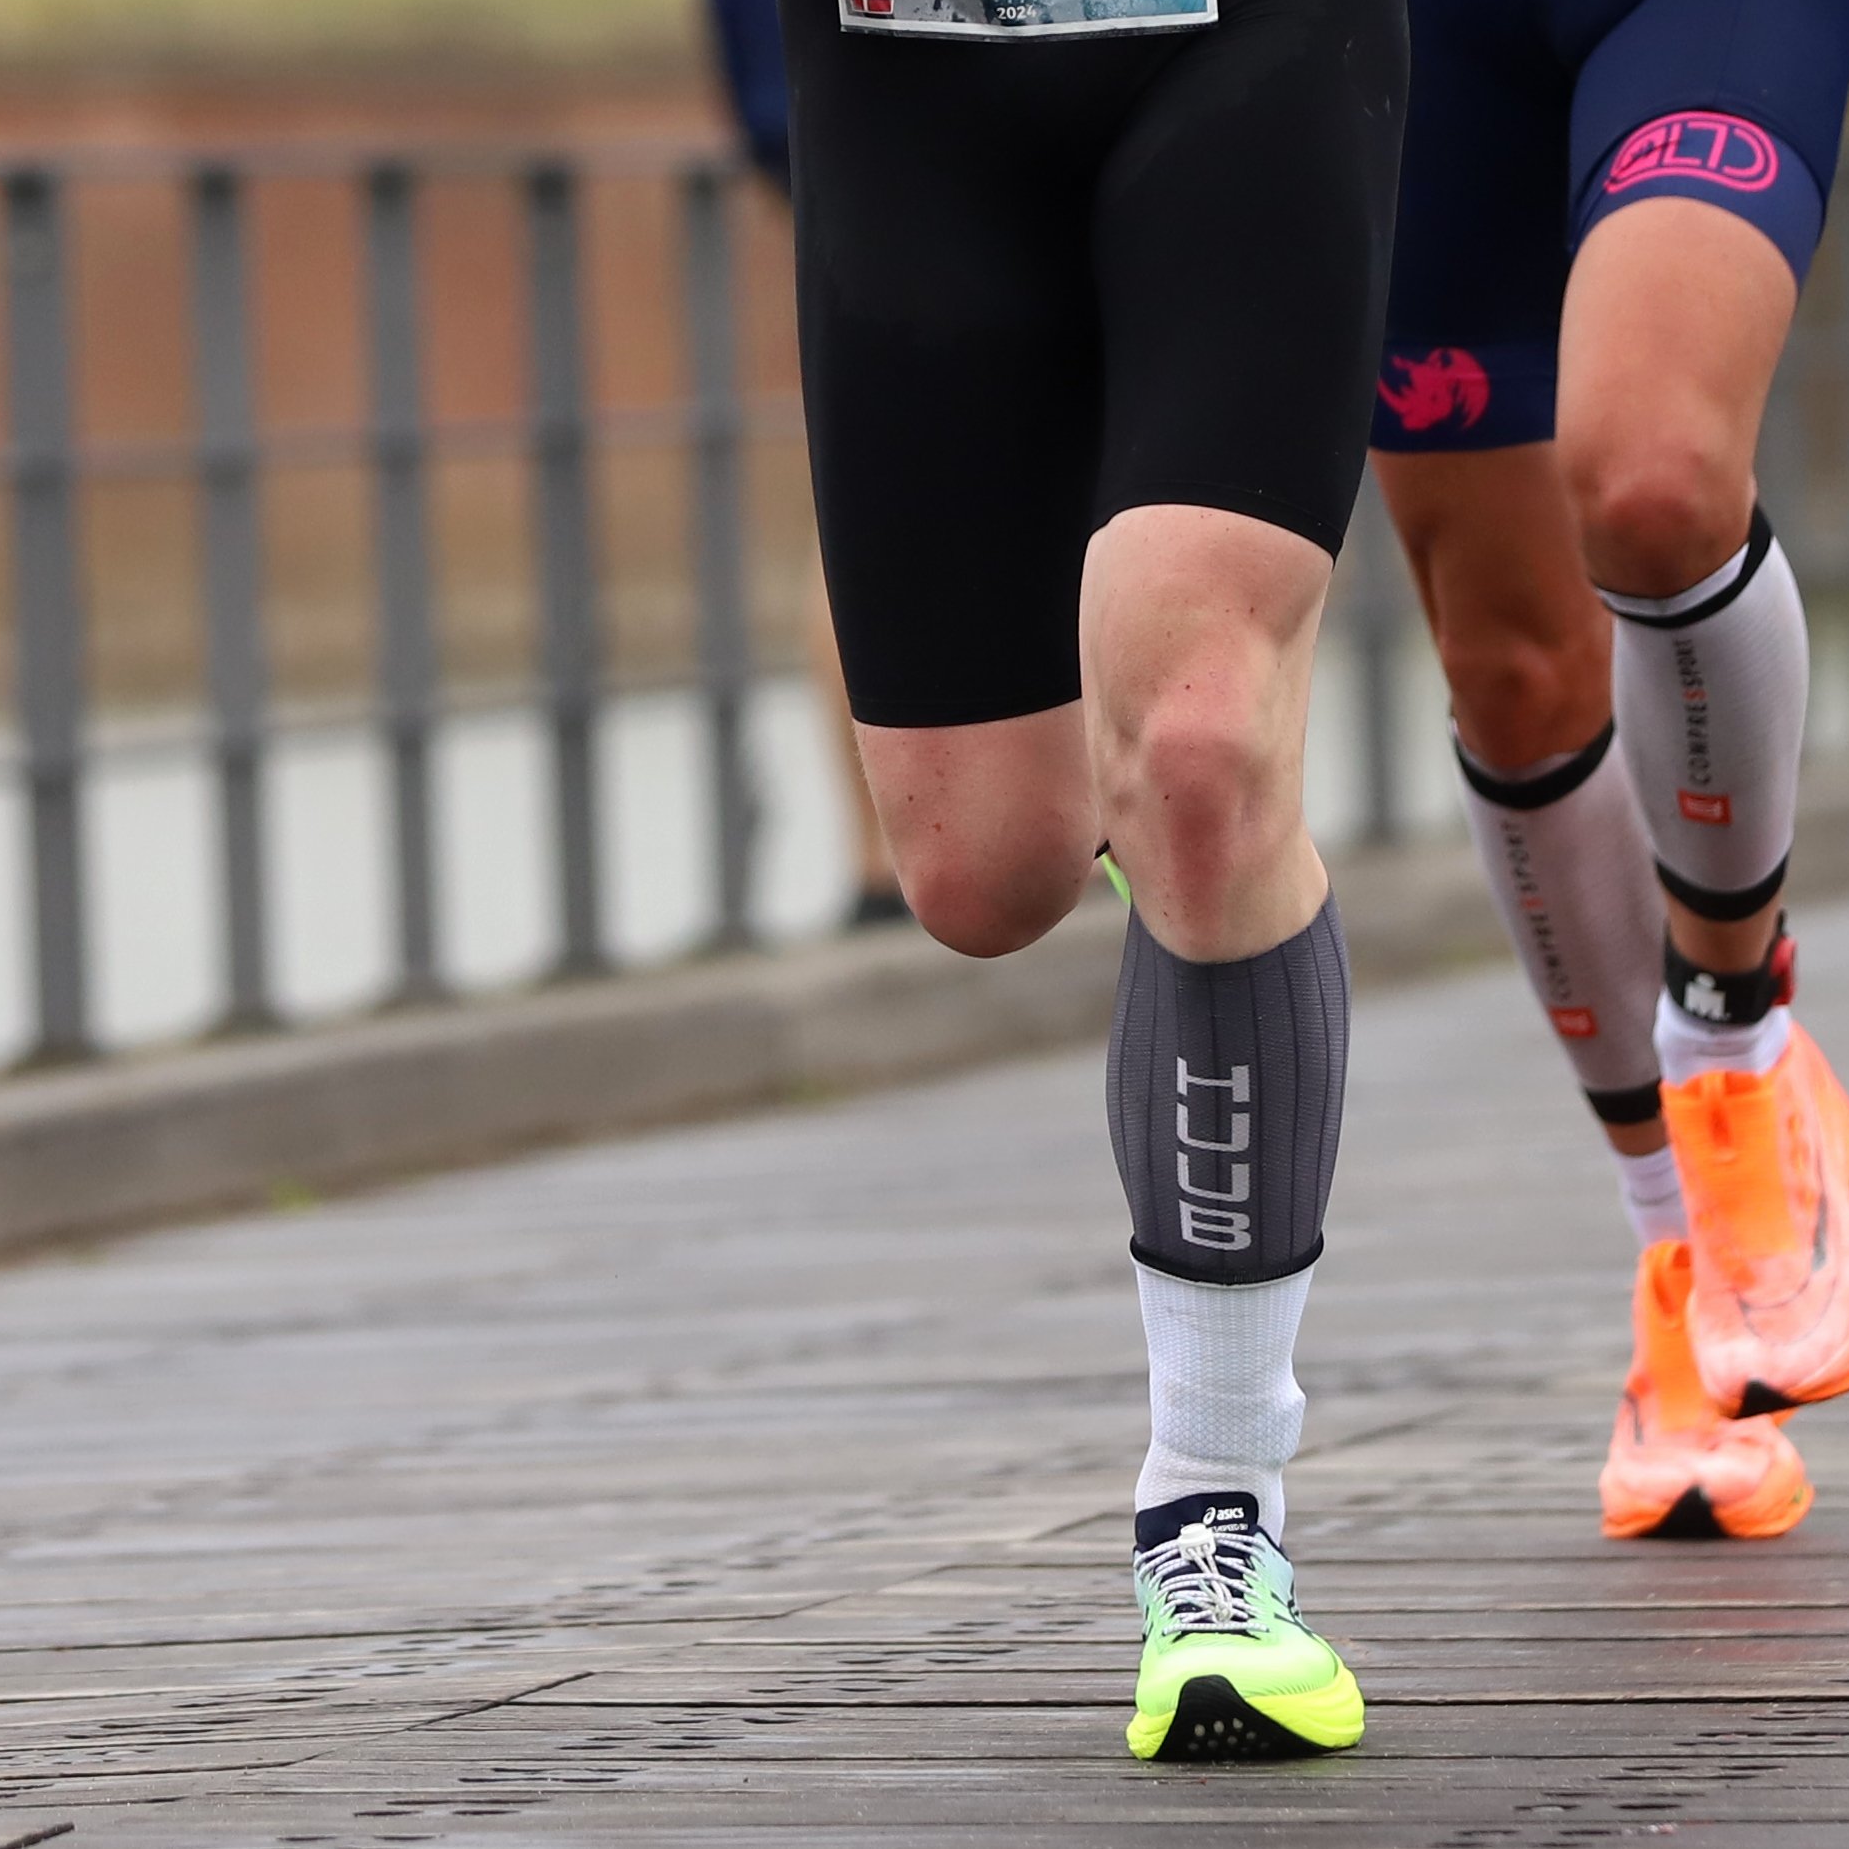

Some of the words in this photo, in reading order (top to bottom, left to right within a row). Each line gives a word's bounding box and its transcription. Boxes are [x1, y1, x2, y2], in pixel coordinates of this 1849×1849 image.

[997, 4, 1037, 21] 2024
[1673, 638, 1711, 786] COMPRESSPORT
[1176, 1056, 1251, 1251] HUUB
[1216, 1507, 1245, 1520] asics
